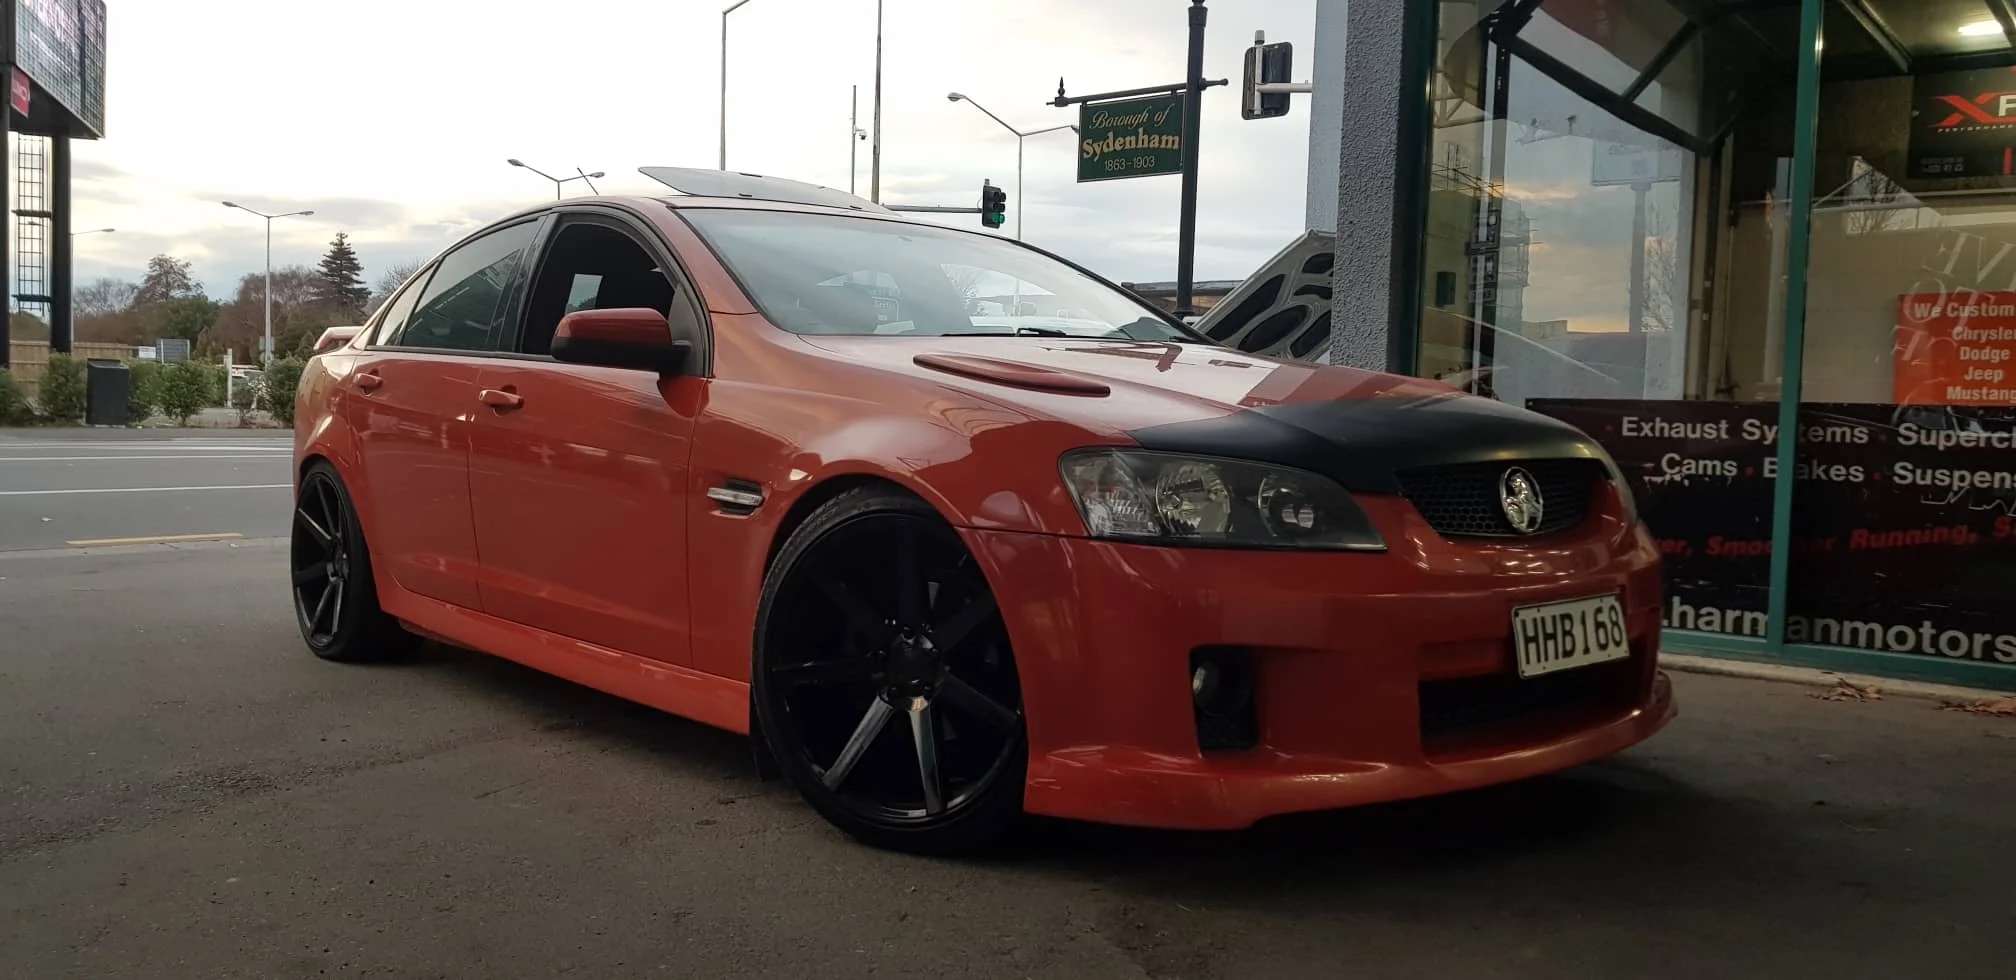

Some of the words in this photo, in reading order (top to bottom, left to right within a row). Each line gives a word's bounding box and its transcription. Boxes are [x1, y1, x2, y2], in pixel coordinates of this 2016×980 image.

[1089, 105, 1152, 130] Borough
[1154, 103, 1175, 127] of
[1082, 127, 1180, 162] Sydenham
[1914, 302, 1943, 319] We
[1959, 346, 2011, 364] Dodge
[1963, 367, 2005, 384] Jeep
[1946, 386, 2016, 404] Mustang
[1621, 417, 1729, 440] Exhaust
[1741, 418, 1870, 446] Sytems
[1661, 453, 1738, 477] Cams
[1762, 455, 1865, 482] Bakes
[1893, 462, 2016, 491] Suspen
[1521, 604, 1623, 665] HHB168
